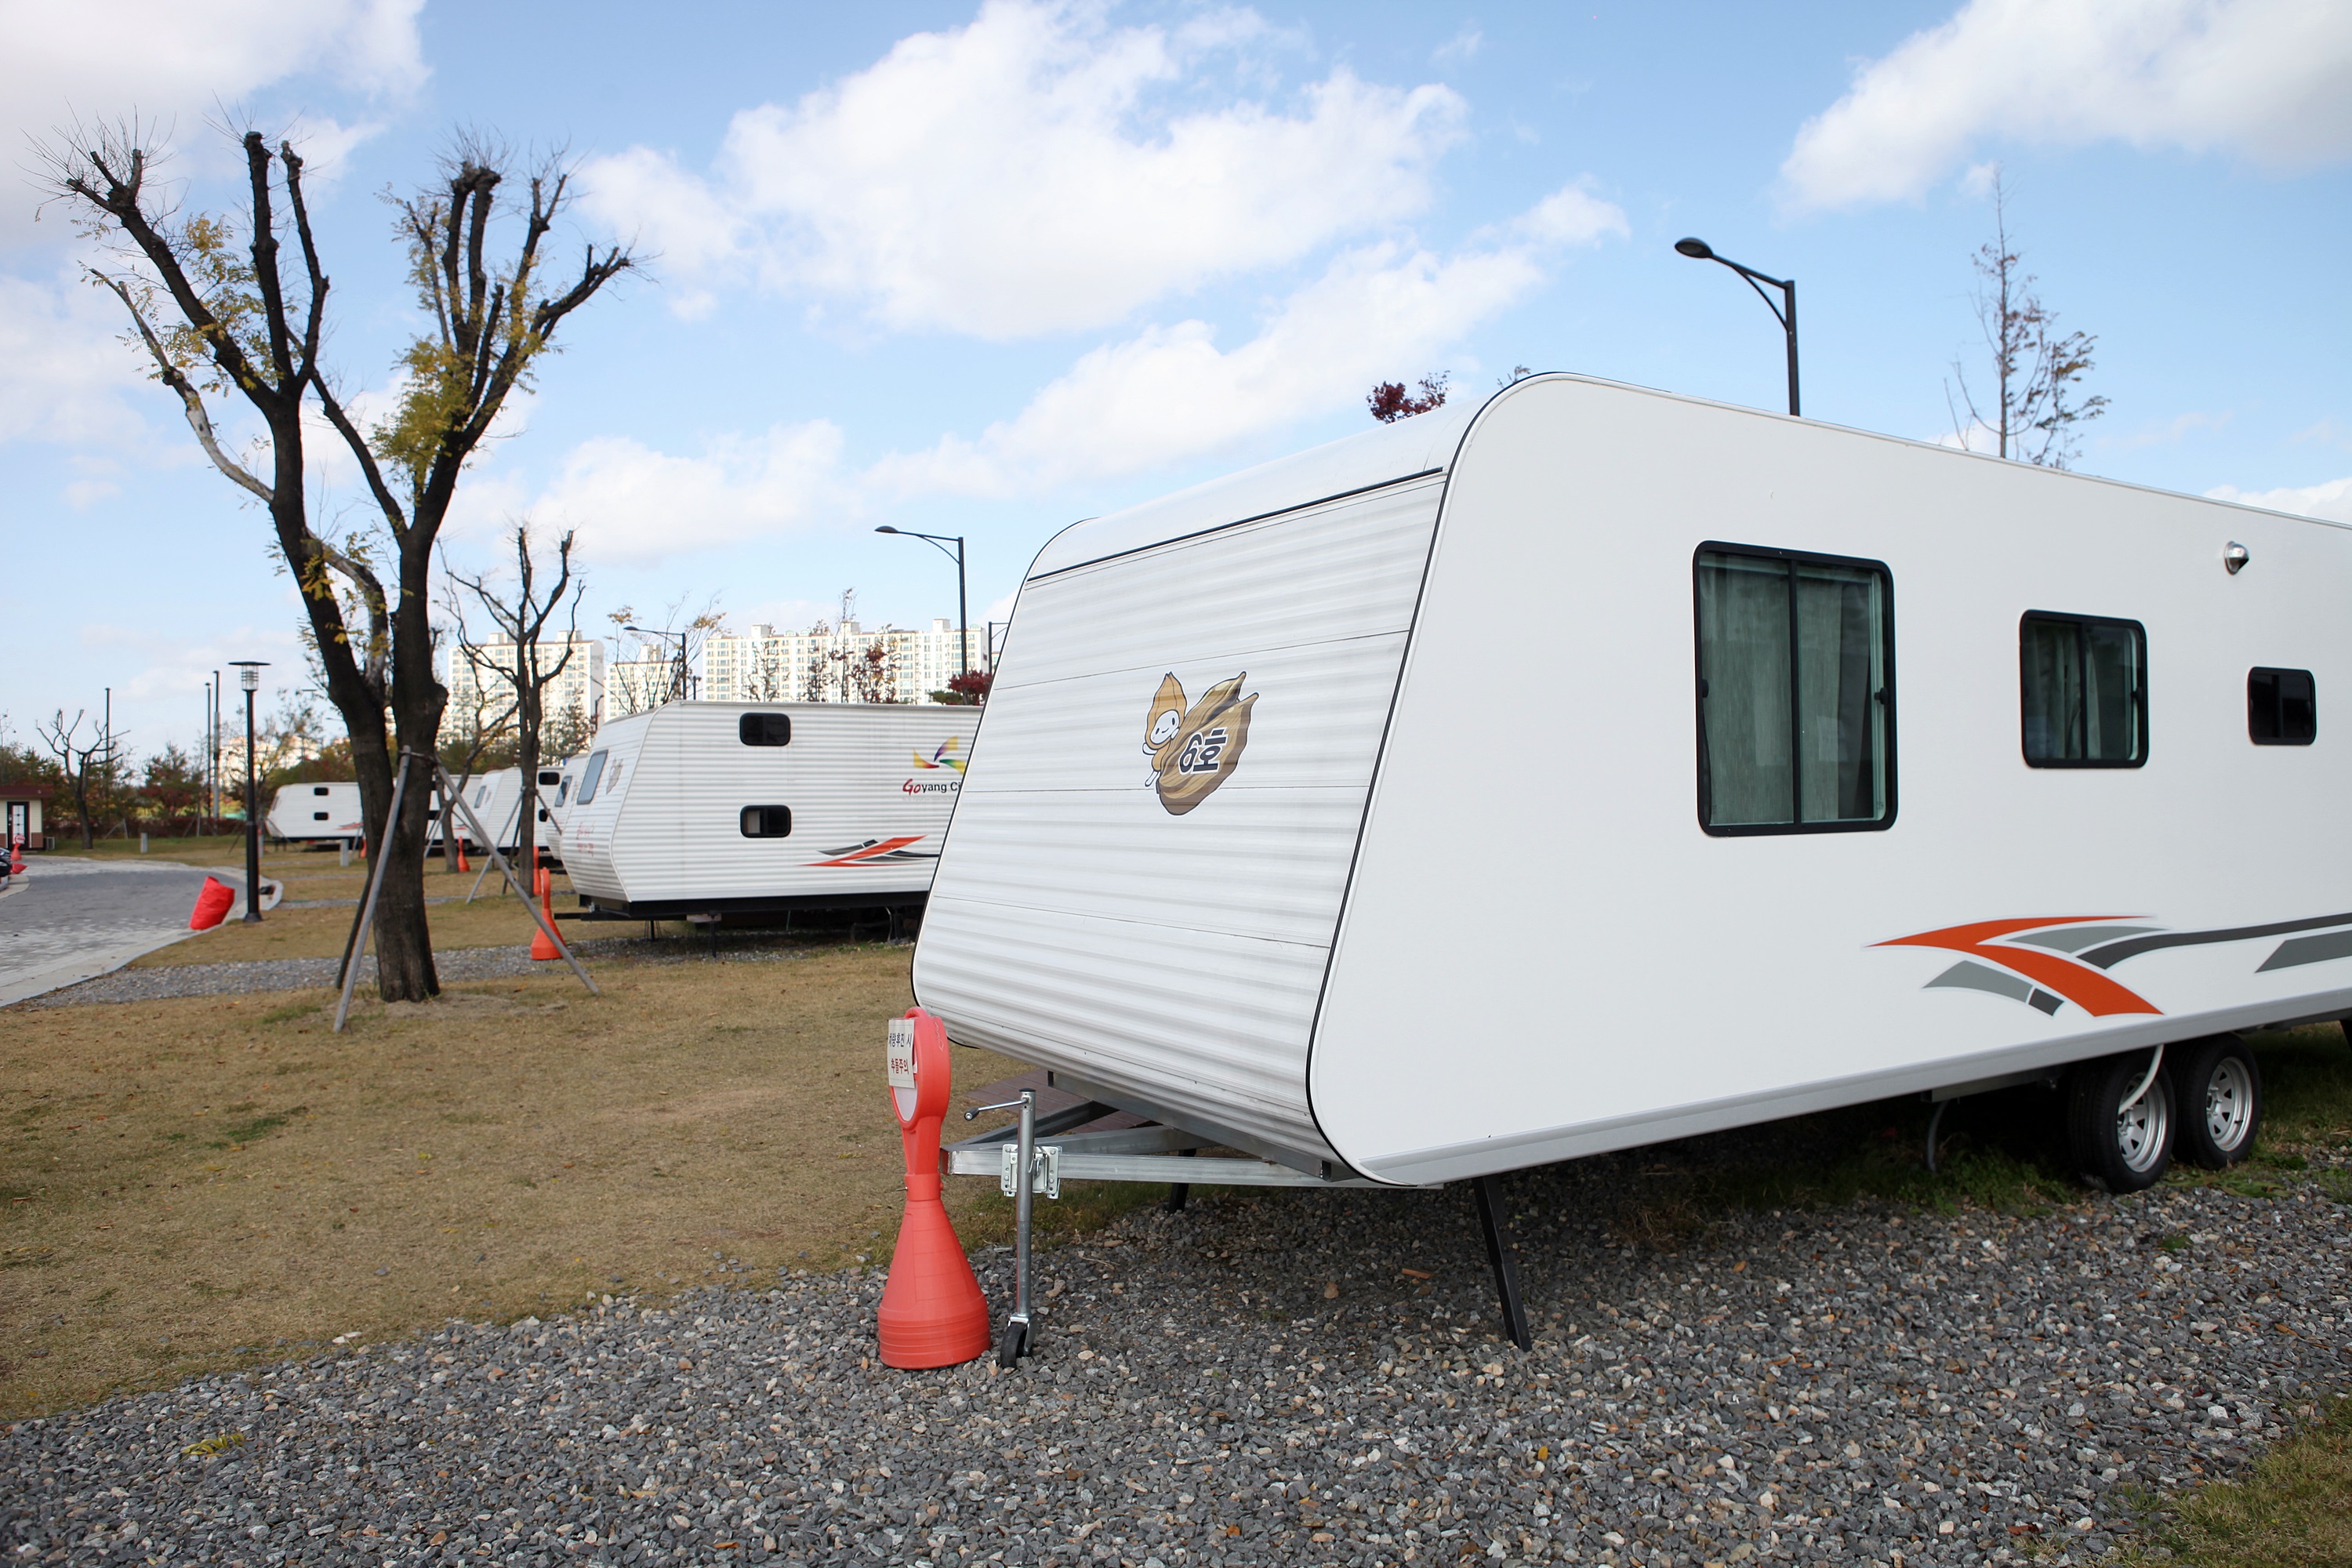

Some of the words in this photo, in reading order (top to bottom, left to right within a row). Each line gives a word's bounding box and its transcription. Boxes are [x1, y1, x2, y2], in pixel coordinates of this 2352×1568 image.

[1179, 728, 1228, 774] 6호
[902, 779, 947, 796] Goyang
[888, 1033, 905, 1047] 차량후진
[906, 1033, 912, 1047] 시
[891, 1058, 909, 1074] 추돌주의
